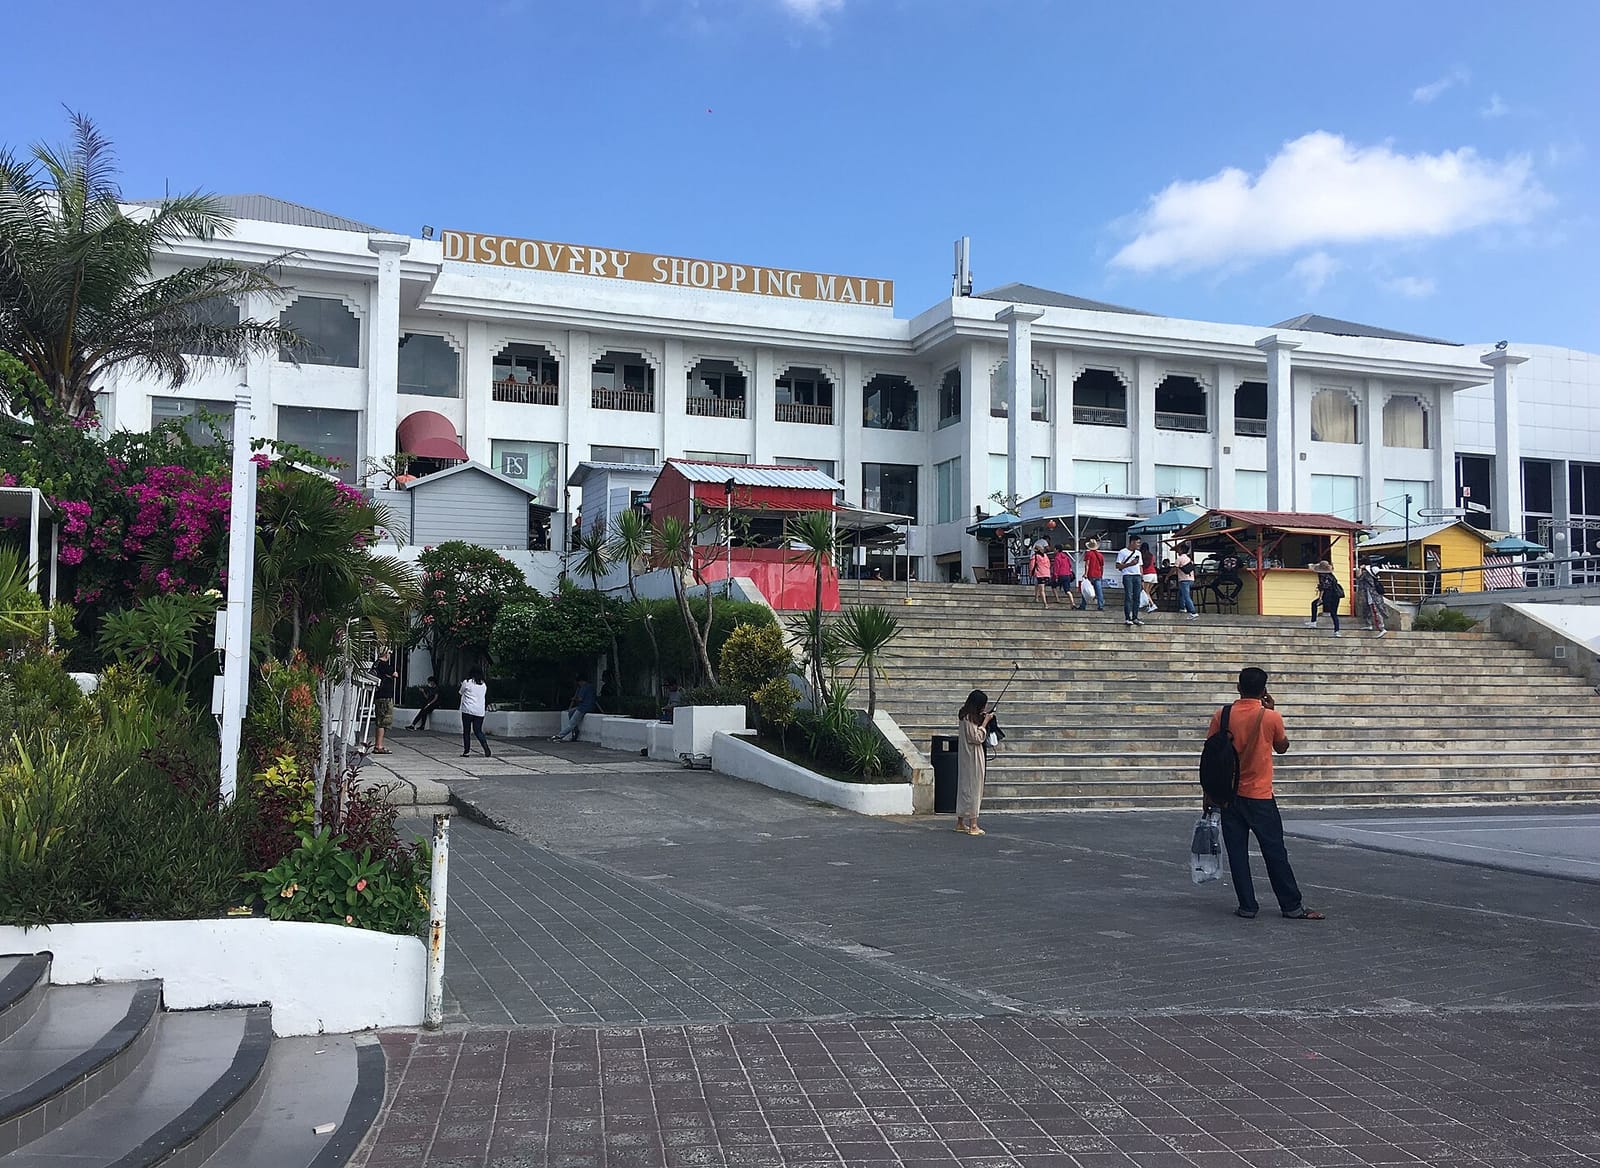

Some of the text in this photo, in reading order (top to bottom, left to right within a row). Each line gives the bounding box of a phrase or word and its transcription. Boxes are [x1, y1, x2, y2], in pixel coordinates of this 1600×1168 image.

[444, 231, 892, 306] DISCOVERY SHOPPING MALL
